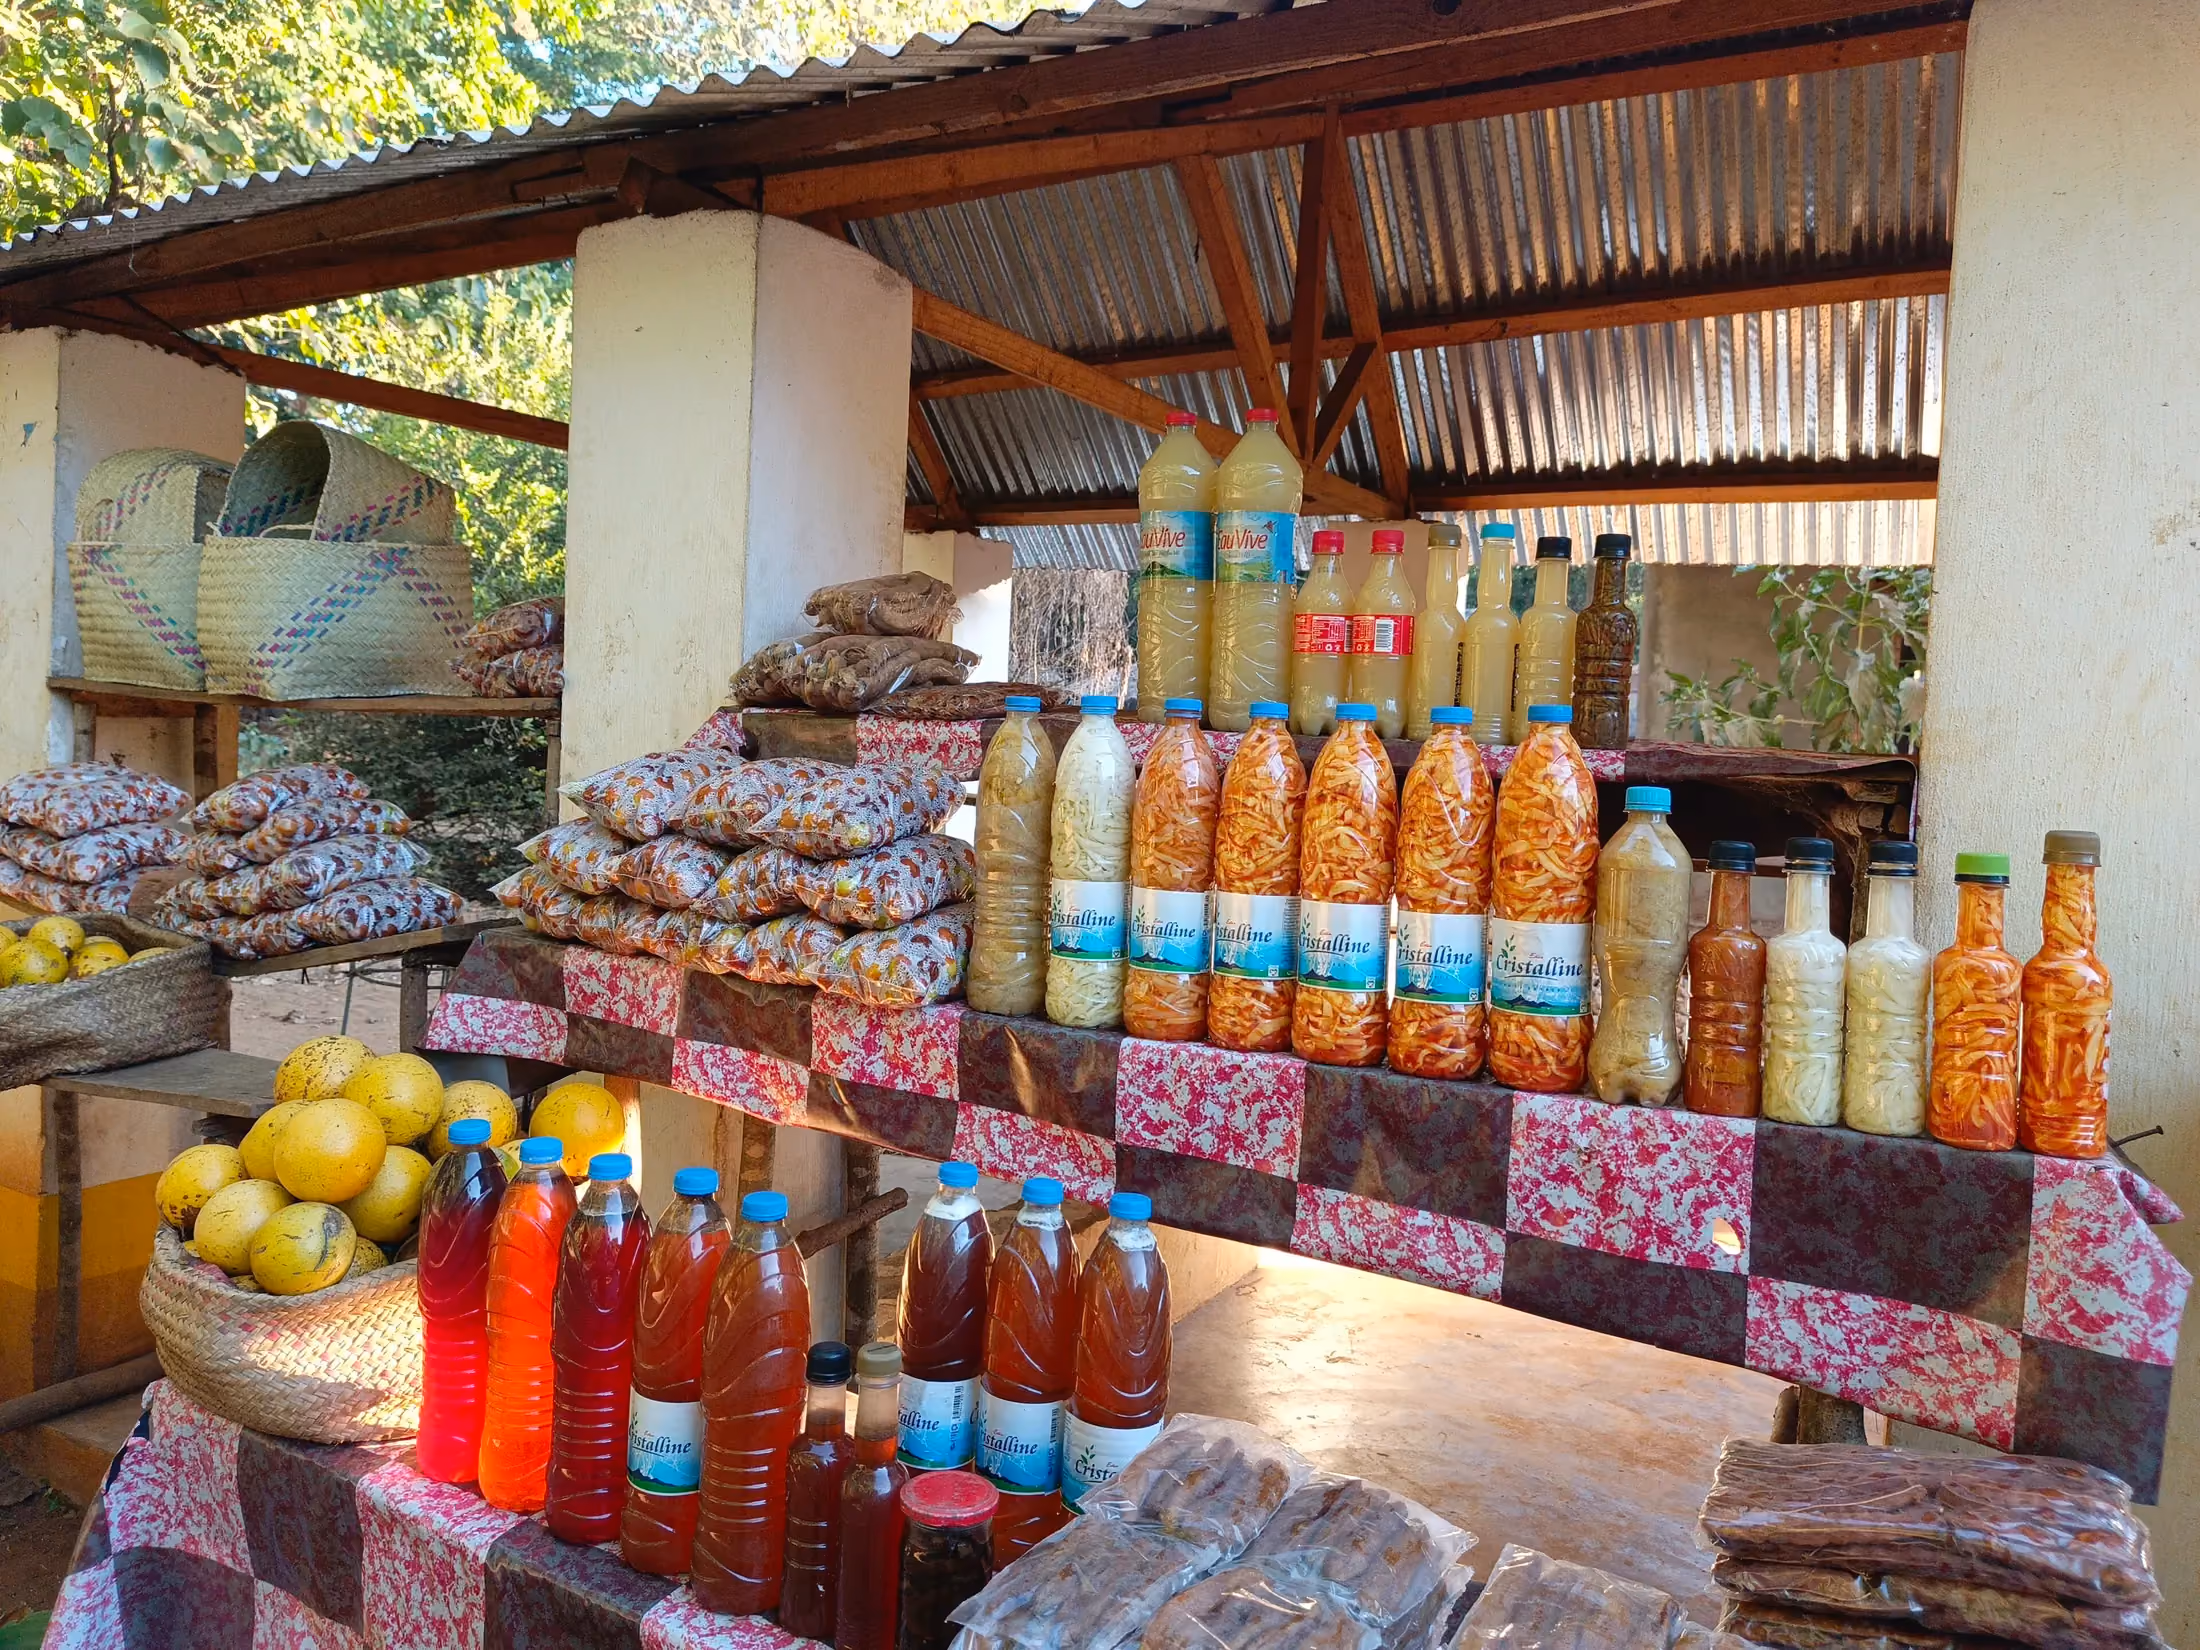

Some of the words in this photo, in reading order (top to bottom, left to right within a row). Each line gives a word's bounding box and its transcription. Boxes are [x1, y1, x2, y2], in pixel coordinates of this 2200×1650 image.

[1140, 526, 1186, 549] auVive
[1052, 909, 1116, 926] ristalline
[1132, 919, 1196, 938] Cristalline
[1217, 922, 1272, 942] istalline
[1398, 944, 1473, 965] ristalline
[1496, 954, 1583, 976] Cristalline
